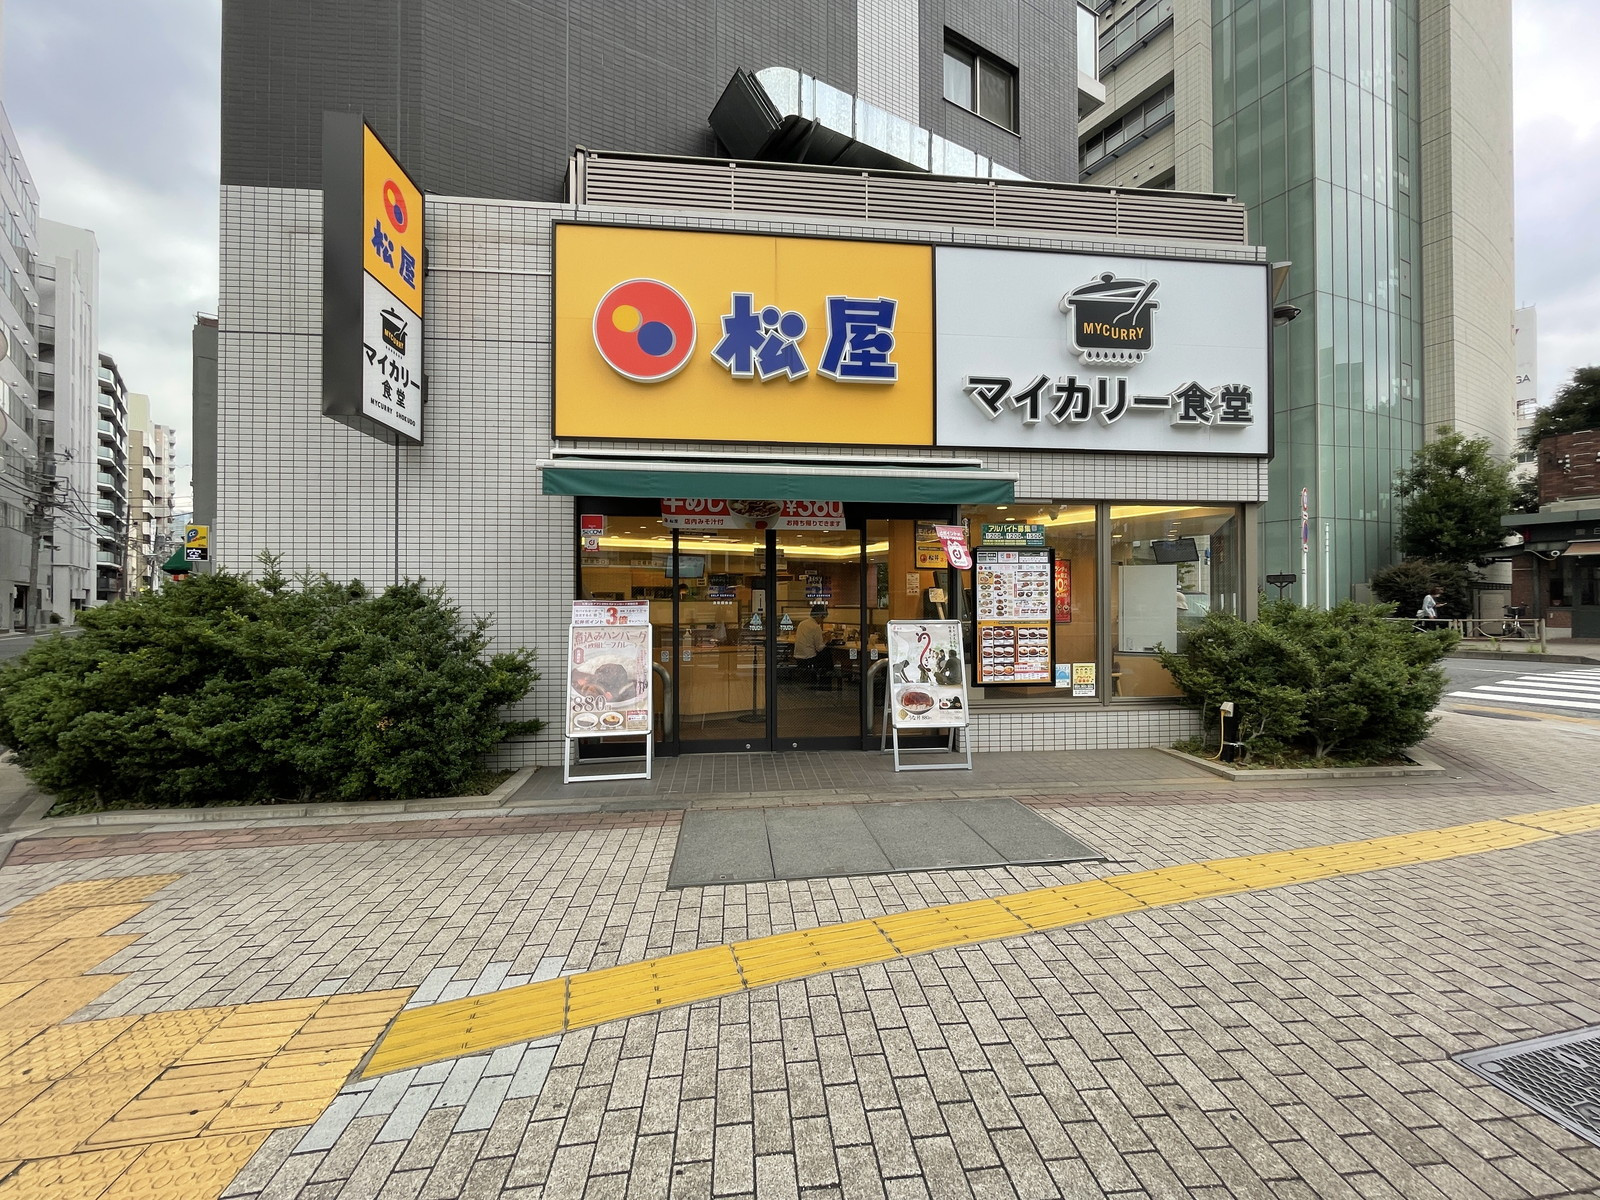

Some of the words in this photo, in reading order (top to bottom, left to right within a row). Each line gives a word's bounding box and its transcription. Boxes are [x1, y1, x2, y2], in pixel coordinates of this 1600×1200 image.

[371, 217, 416, 291] 松屋
[384, 327, 405, 350] MYCURRY
[711, 291, 899, 385] 松屋
[1083, 321, 1145, 341] MYCURRY
[363, 341, 421, 391] マイカリー
[381, 379, 406, 410] 食堂
[963, 373, 1255, 427] マイカリー食堂
[370, 396, 394, 415] MYCURRY
[395, 410, 416, 428] SHOKUDO
[684, 518, 724, 526] 店内みそ汁付
[988, 525, 1031, 533] アルバイト募集
[187, 548, 201, 560] 空
